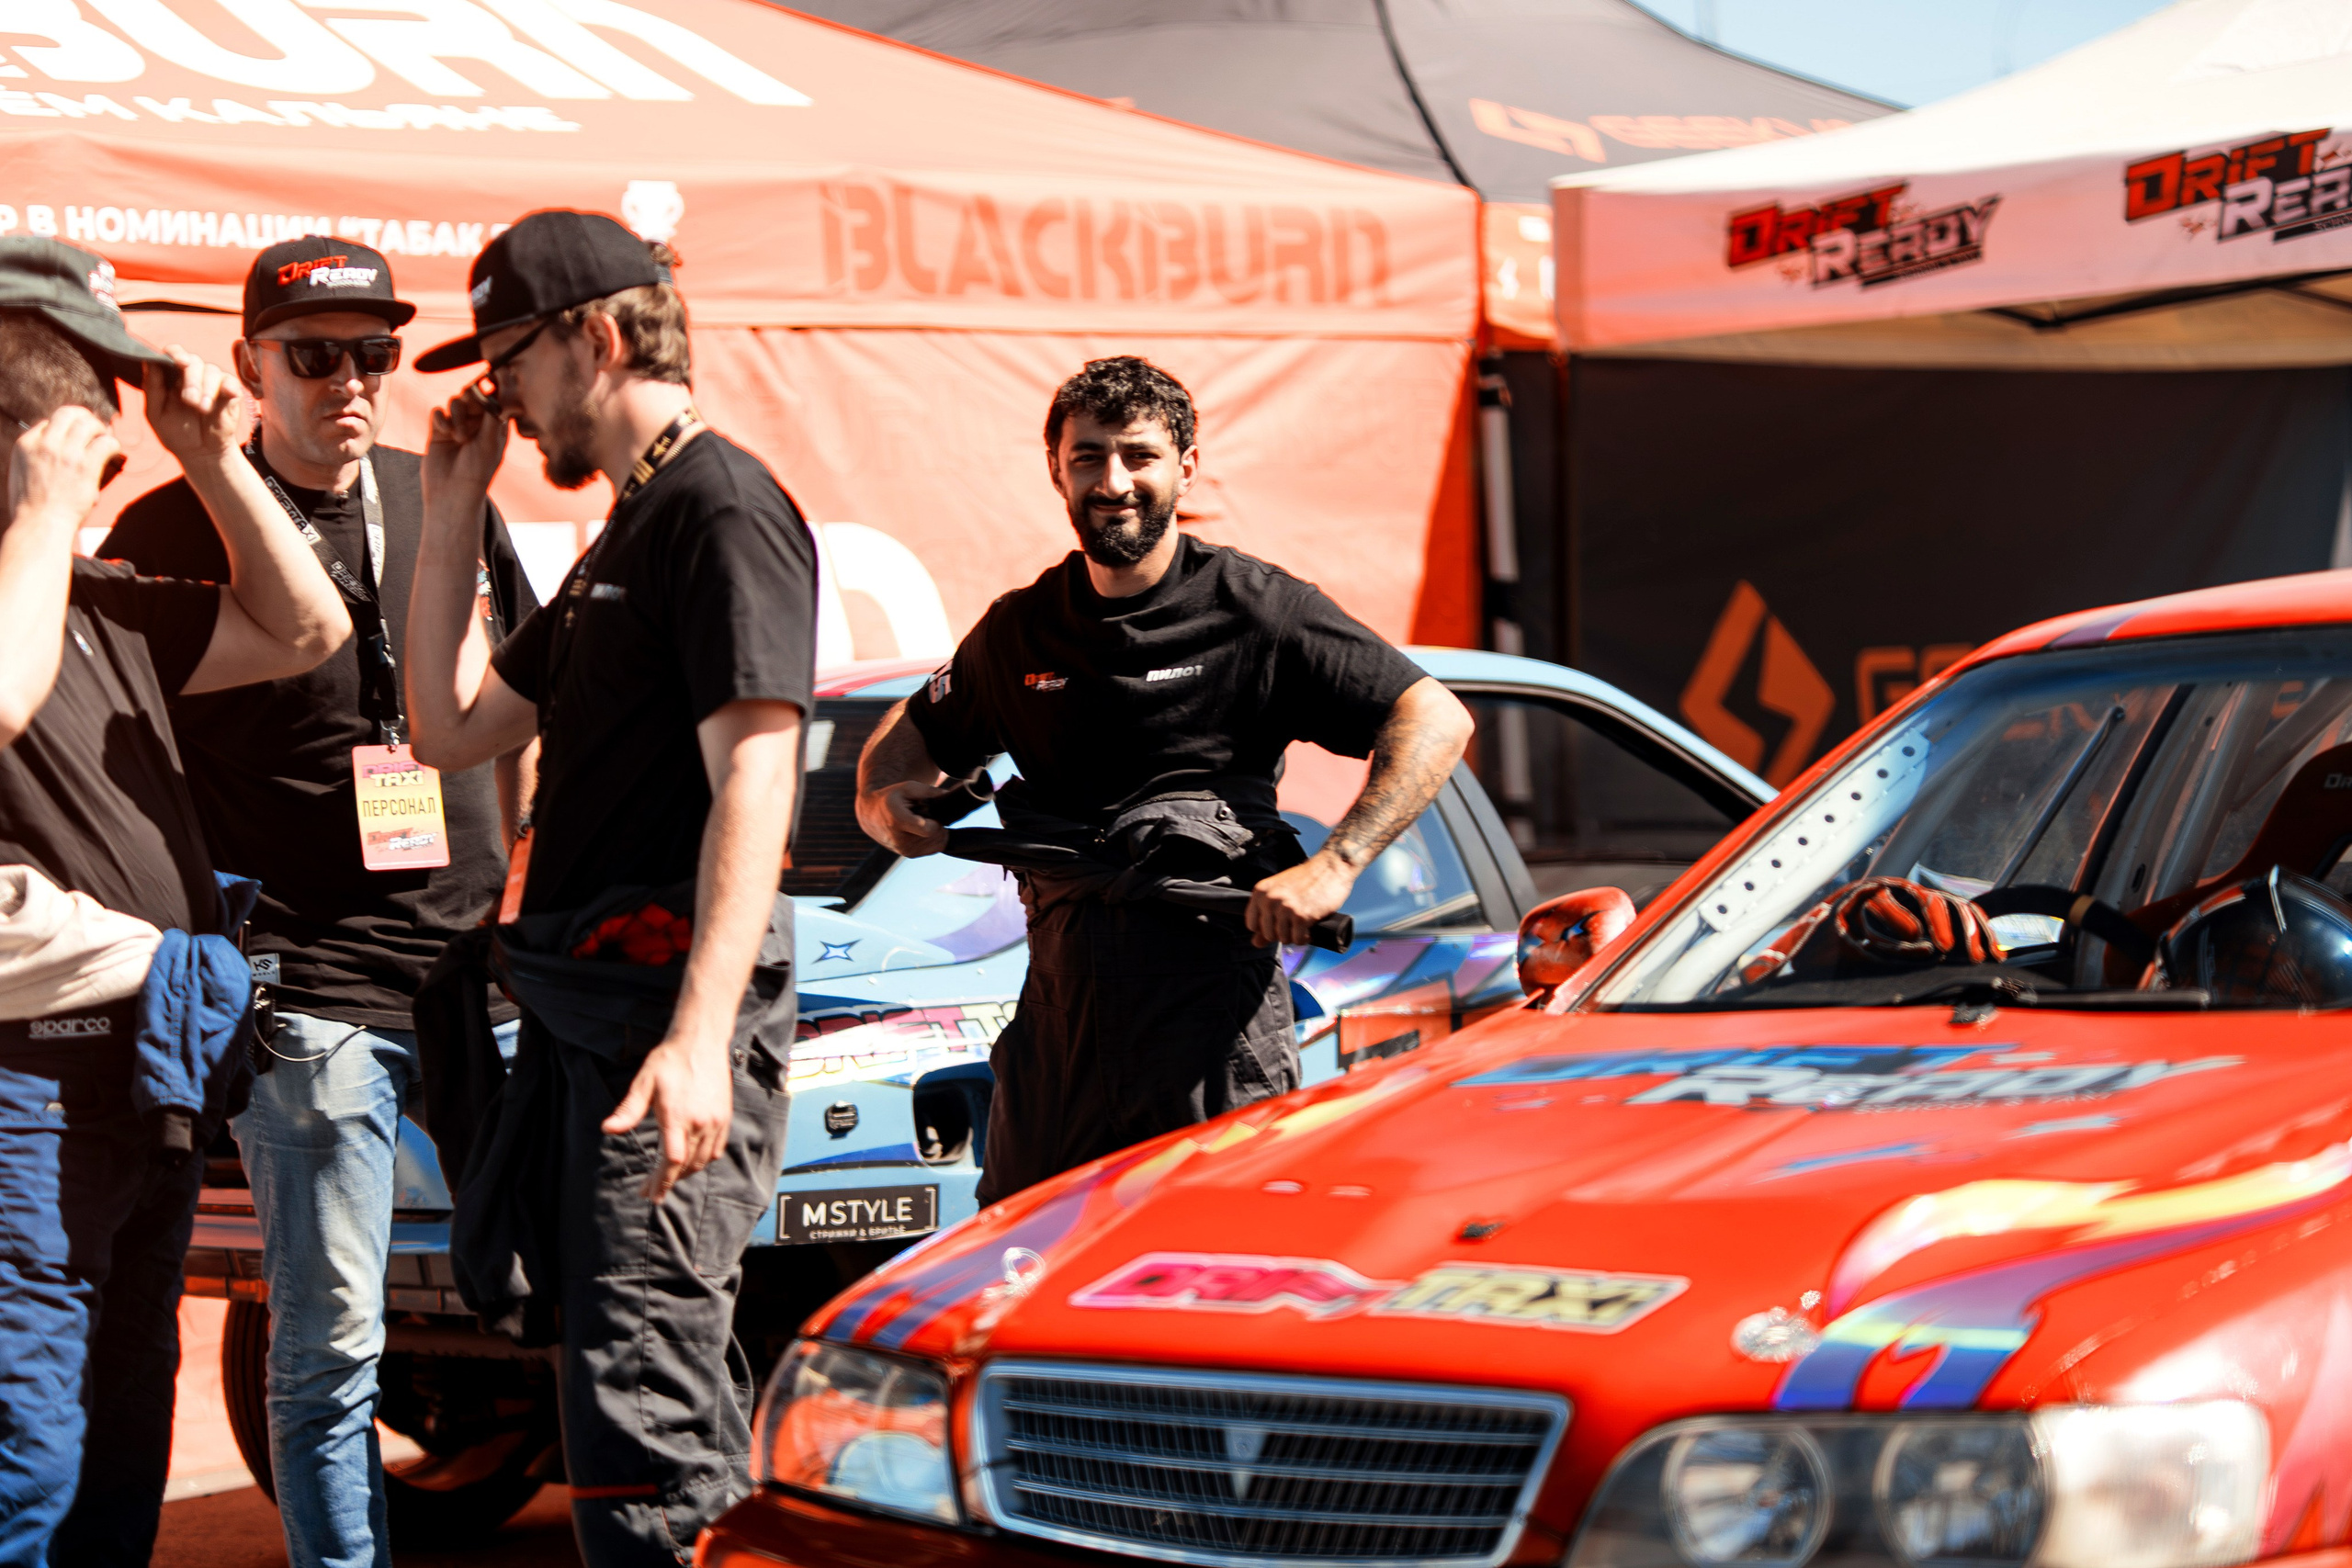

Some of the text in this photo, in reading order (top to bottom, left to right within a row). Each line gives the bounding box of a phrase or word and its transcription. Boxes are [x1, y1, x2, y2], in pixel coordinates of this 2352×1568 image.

[2124, 127, 2334, 222] DRIFT
[1726, 181, 1907, 269] DRIFT
[2217, 164, 2352, 243] REA
[26, 204, 58, 238] В
[65, 205, 331, 250] НОМИНАЦИИ
[821, 183, 1390, 307] BLACKBURN
[1811, 195, 2002, 287] READY
[277, 254, 348, 286] DRIFT
[309, 265, 378, 286] READY
[369, 770, 424, 787] TAXI
[362, 796, 436, 818] ПЕРСОНАЛ
[29, 1017, 111, 1039] sparco
